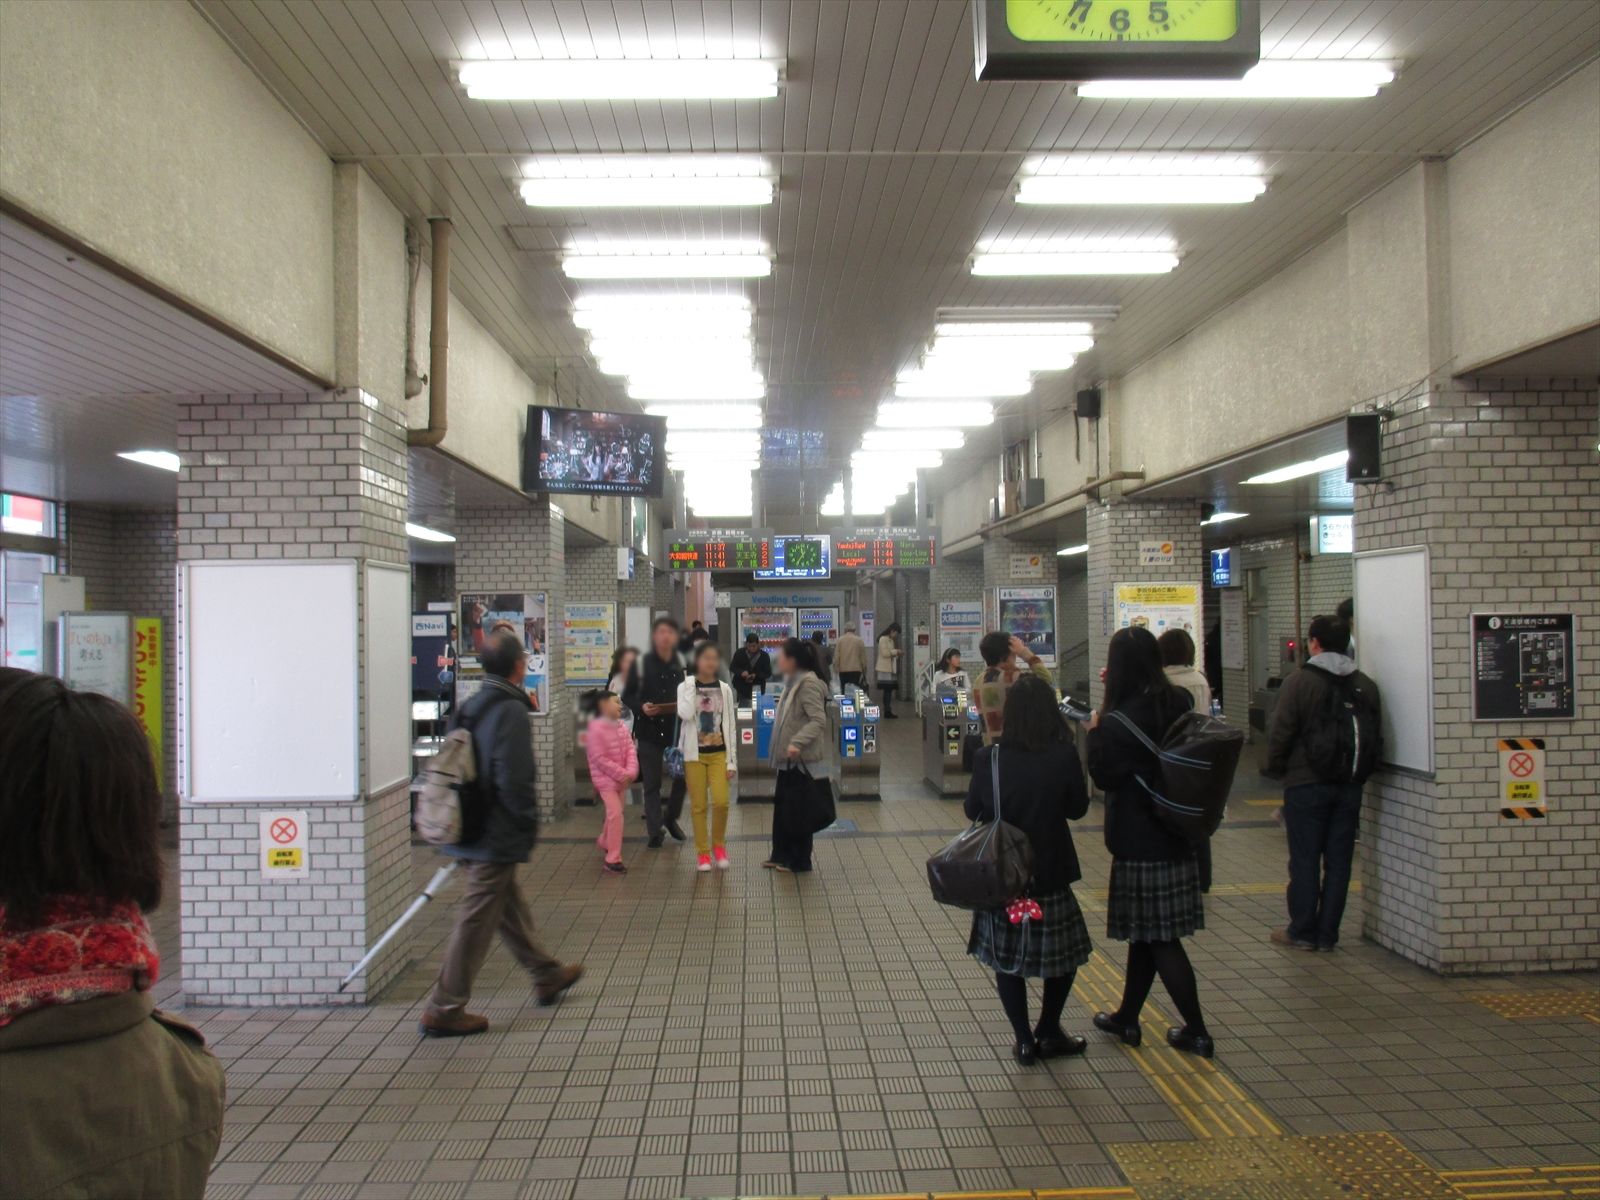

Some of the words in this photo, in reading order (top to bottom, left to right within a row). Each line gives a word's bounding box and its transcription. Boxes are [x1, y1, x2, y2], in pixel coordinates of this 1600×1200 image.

[1148, 1, 1168, 23] 5
[1109, 9, 1130, 31] 6
[705, 543, 726, 551] 11:37
[761, 543, 768, 551] 2
[873, 541, 893, 549] 11:40
[705, 552, 726, 560] 11:41
[736, 552, 757, 560] 天王寺
[705, 560, 726, 568] 11:44
[761, 560, 768, 568] 2
[752, 594, 788, 605] Vending
[791, 594, 823, 603] Corner
[79, 648, 104, 661] 考える
[845, 729, 857, 740] IC
